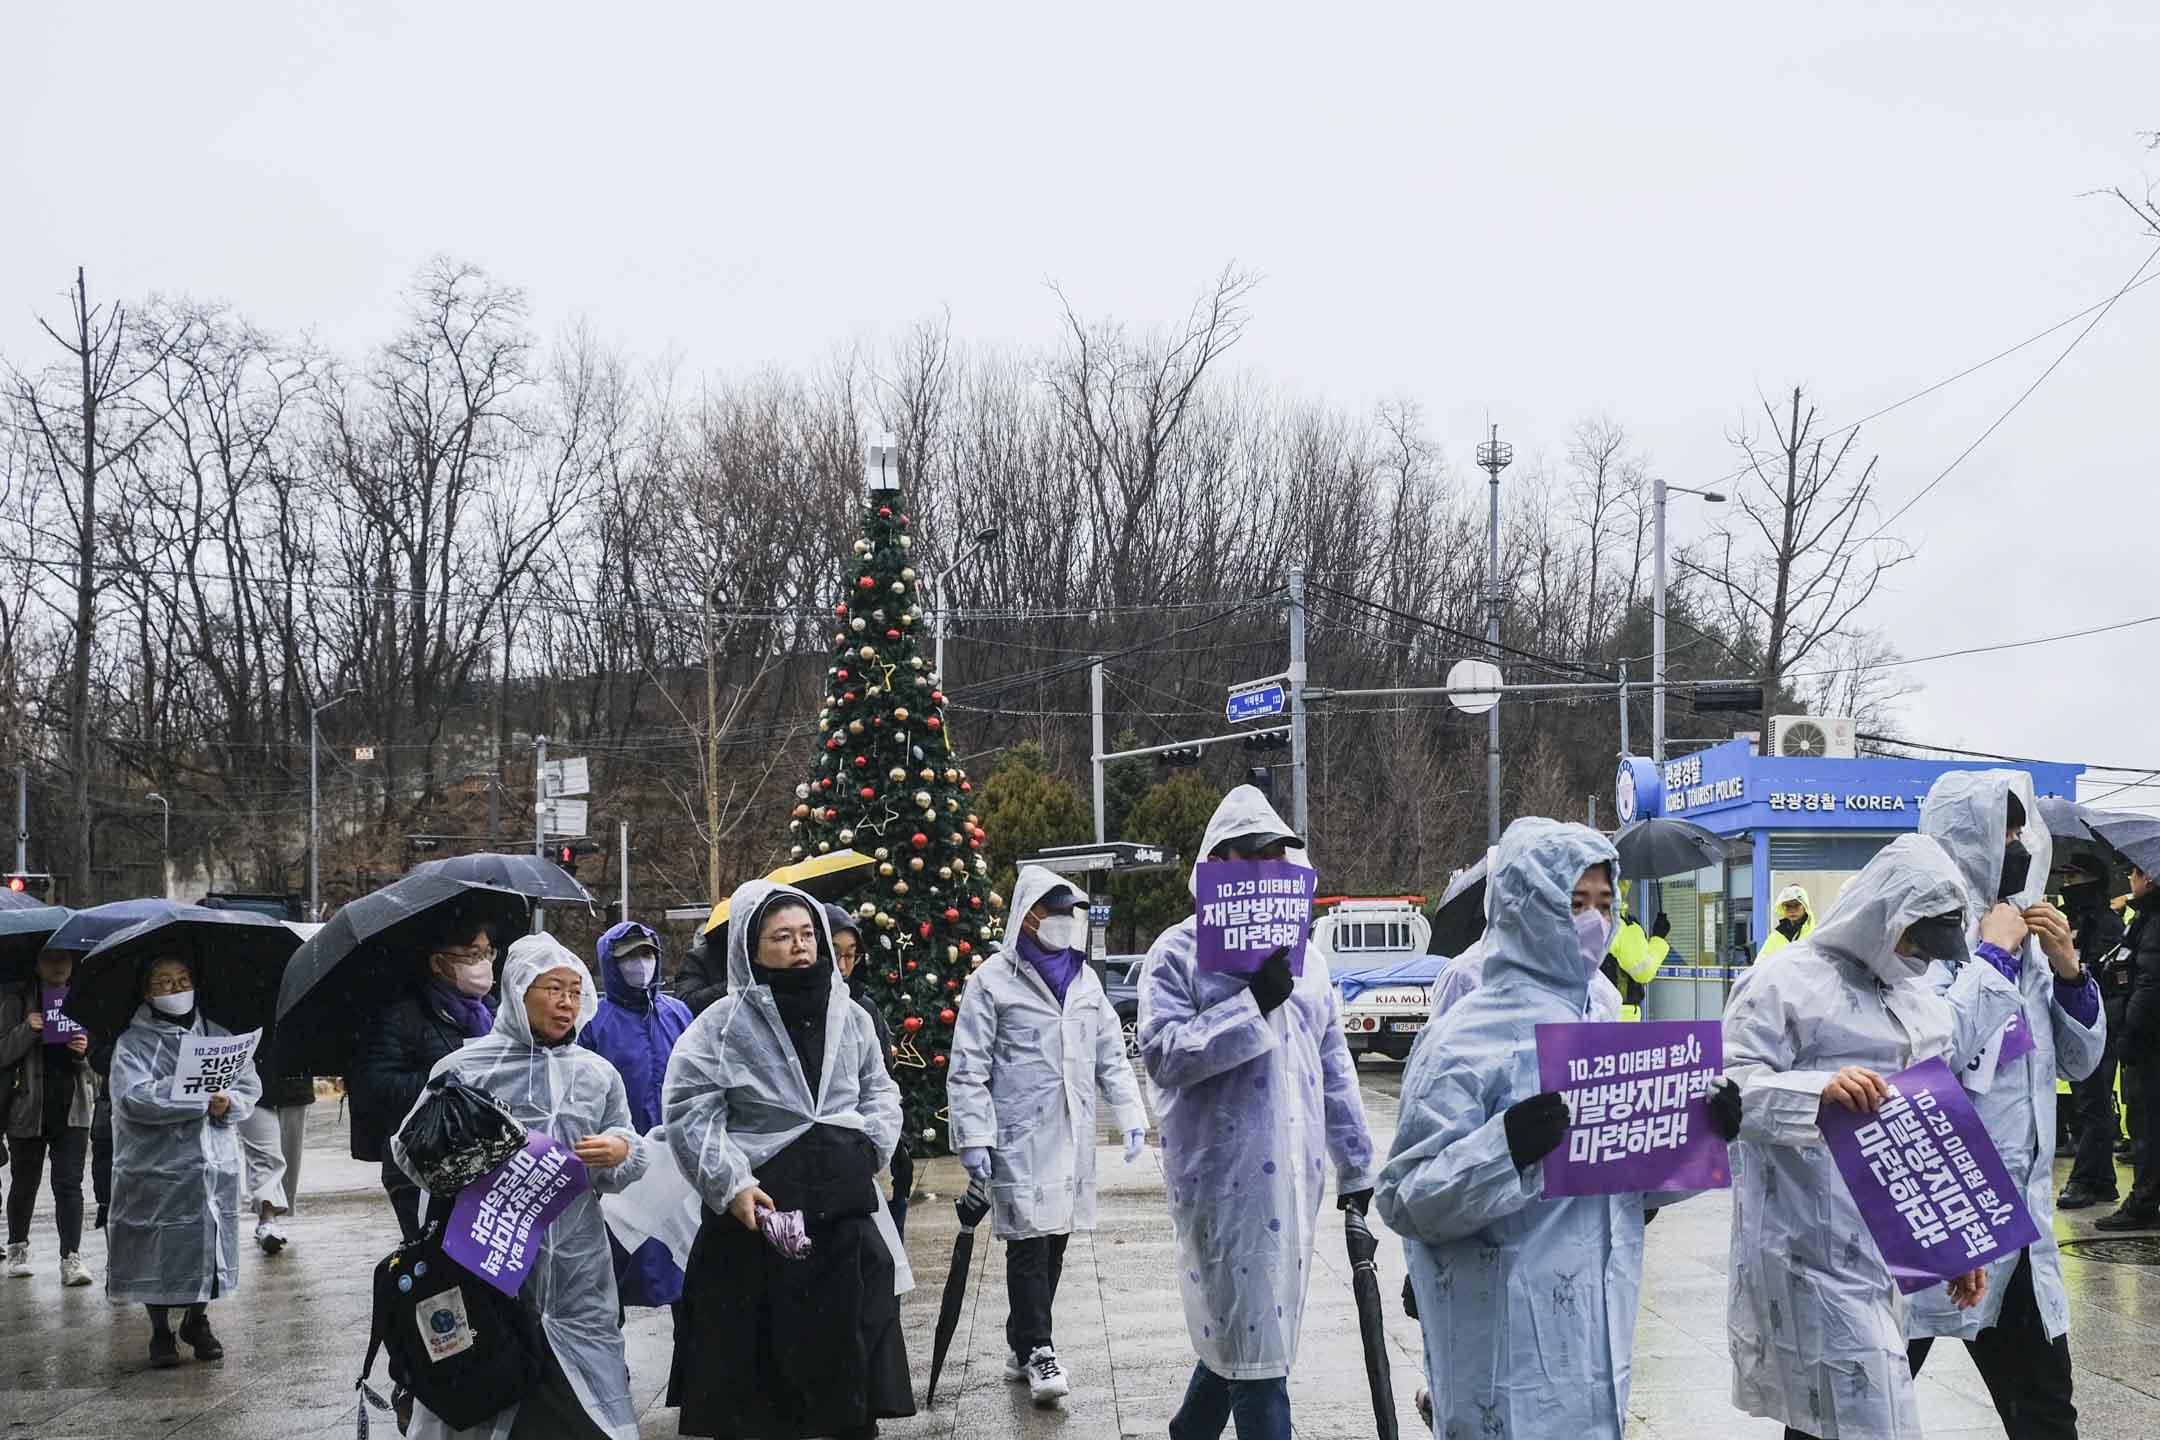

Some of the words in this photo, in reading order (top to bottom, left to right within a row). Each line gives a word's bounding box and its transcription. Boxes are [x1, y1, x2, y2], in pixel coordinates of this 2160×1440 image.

[1665, 756, 1702, 790] 관광경찰
[1665, 791, 1686, 812] KOREA
[1687, 784, 1716, 807] TOURIST
[1716, 777, 1745, 801] POLICE
[1769, 792, 1837, 812] 관광경찰
[1845, 795, 1904, 810] KOREA
[1217, 880, 1255, 898] 10.29
[1258, 879, 1291, 894] 이태원
[1202, 897, 1309, 927] 재발방지대책
[1375, 994, 1397, 1004] KIA
[194, 1047, 219, 1056] 10.29
[200, 1050, 247, 1075] 진상을
[1568, 1055, 1615, 1081] 10.29
[1619, 1047, 1666, 1073] 이태원
[1670, 1033, 1701, 1067] 참사
[1569, 1112, 1688, 1164] 마련하라!
[1912, 1088, 1953, 1137] 10.29
[1943, 1136, 1987, 1190] 이태원
[1976, 1187, 2014, 1227] 참사
[470, 1149, 537, 1246] 마련하라!
[539, 1173, 572, 1206] 10.29
[1854, 1120, 1950, 1249] 마련하라!
[480, 1146, 568, 1277] 재발방지대책
[516, 1203, 543, 1244] 이태원
